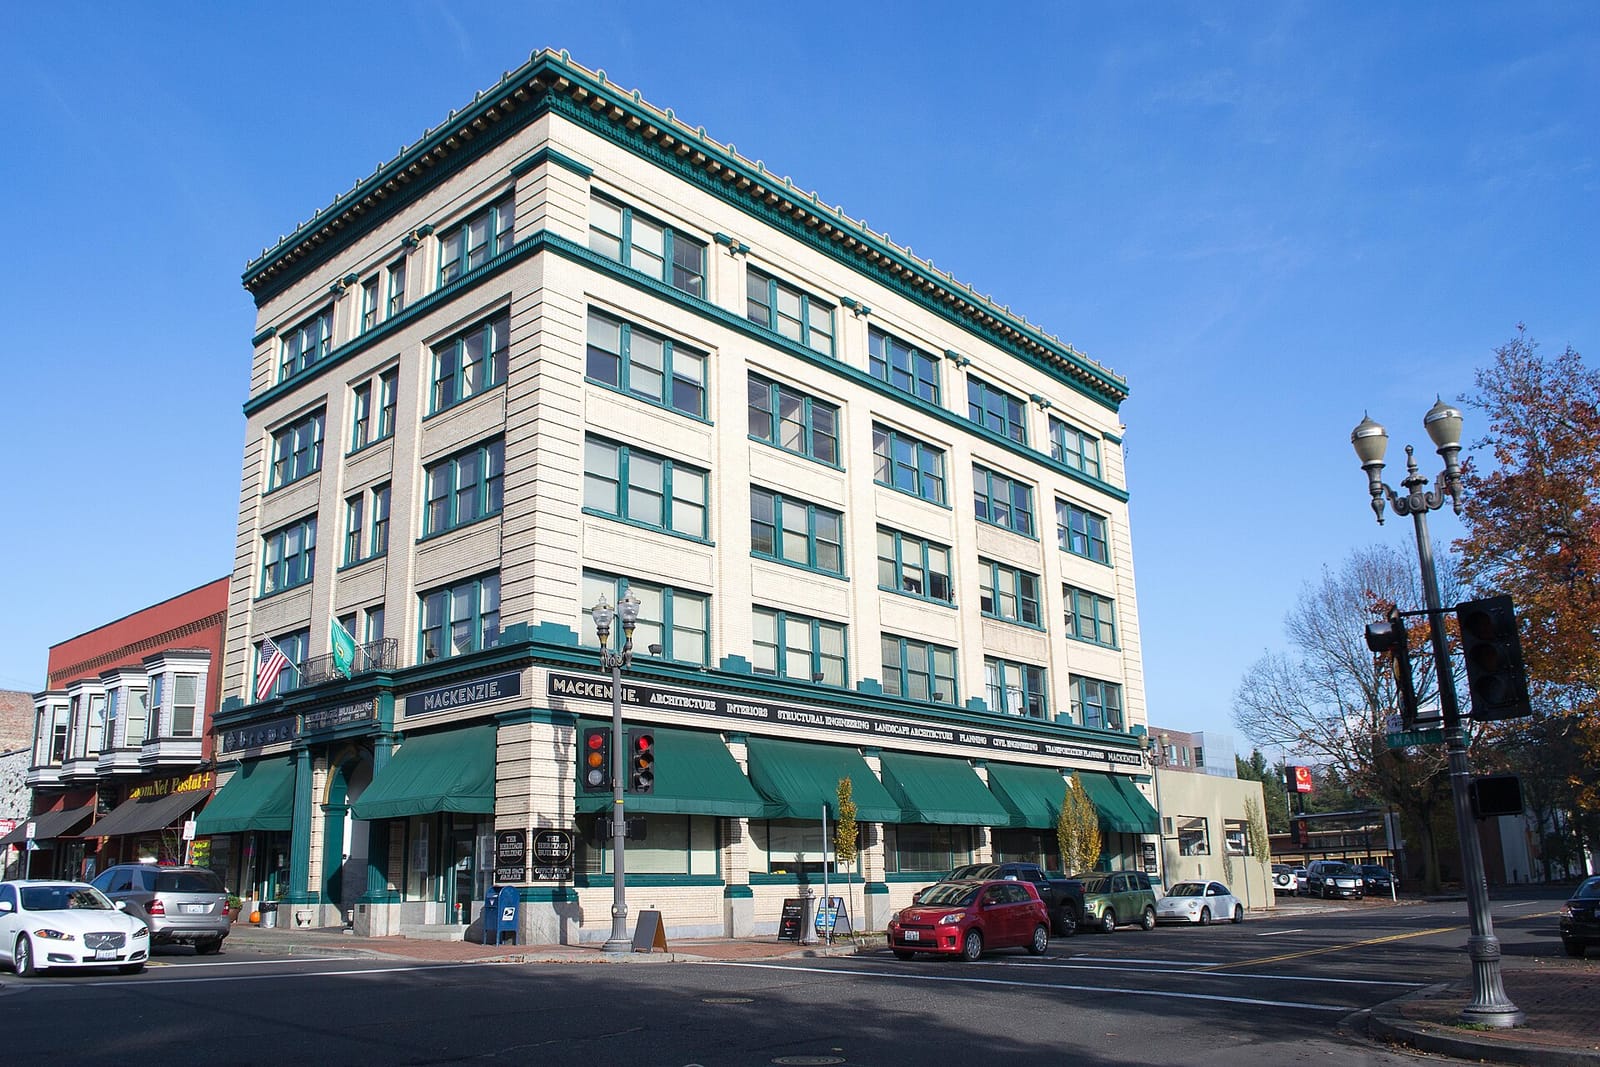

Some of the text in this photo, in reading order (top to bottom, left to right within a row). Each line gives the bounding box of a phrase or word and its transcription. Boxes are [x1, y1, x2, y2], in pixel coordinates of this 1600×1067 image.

[424, 682, 501, 710] MACKENZIE.
[338, 701, 373, 716] BUILDING
[553, 678, 639, 702] MACKENIE.
[650, 693, 716, 710] ARCHITECTURE
[726, 703, 768, 717] INTERIORS
[777, 710, 825, 725] STRUCTURAL
[825, 716, 870, 730] ENGINEERING
[874, 722, 910, 735] LANDSCAPE
[910, 728, 953, 740] ARCHITECTURE
[960, 734, 987, 744] PLANNING
[993, 738, 1007, 747] CIVIL
[1394, 731, 1427, 746] MAIN
[537, 842, 568, 850] HERITAGE
